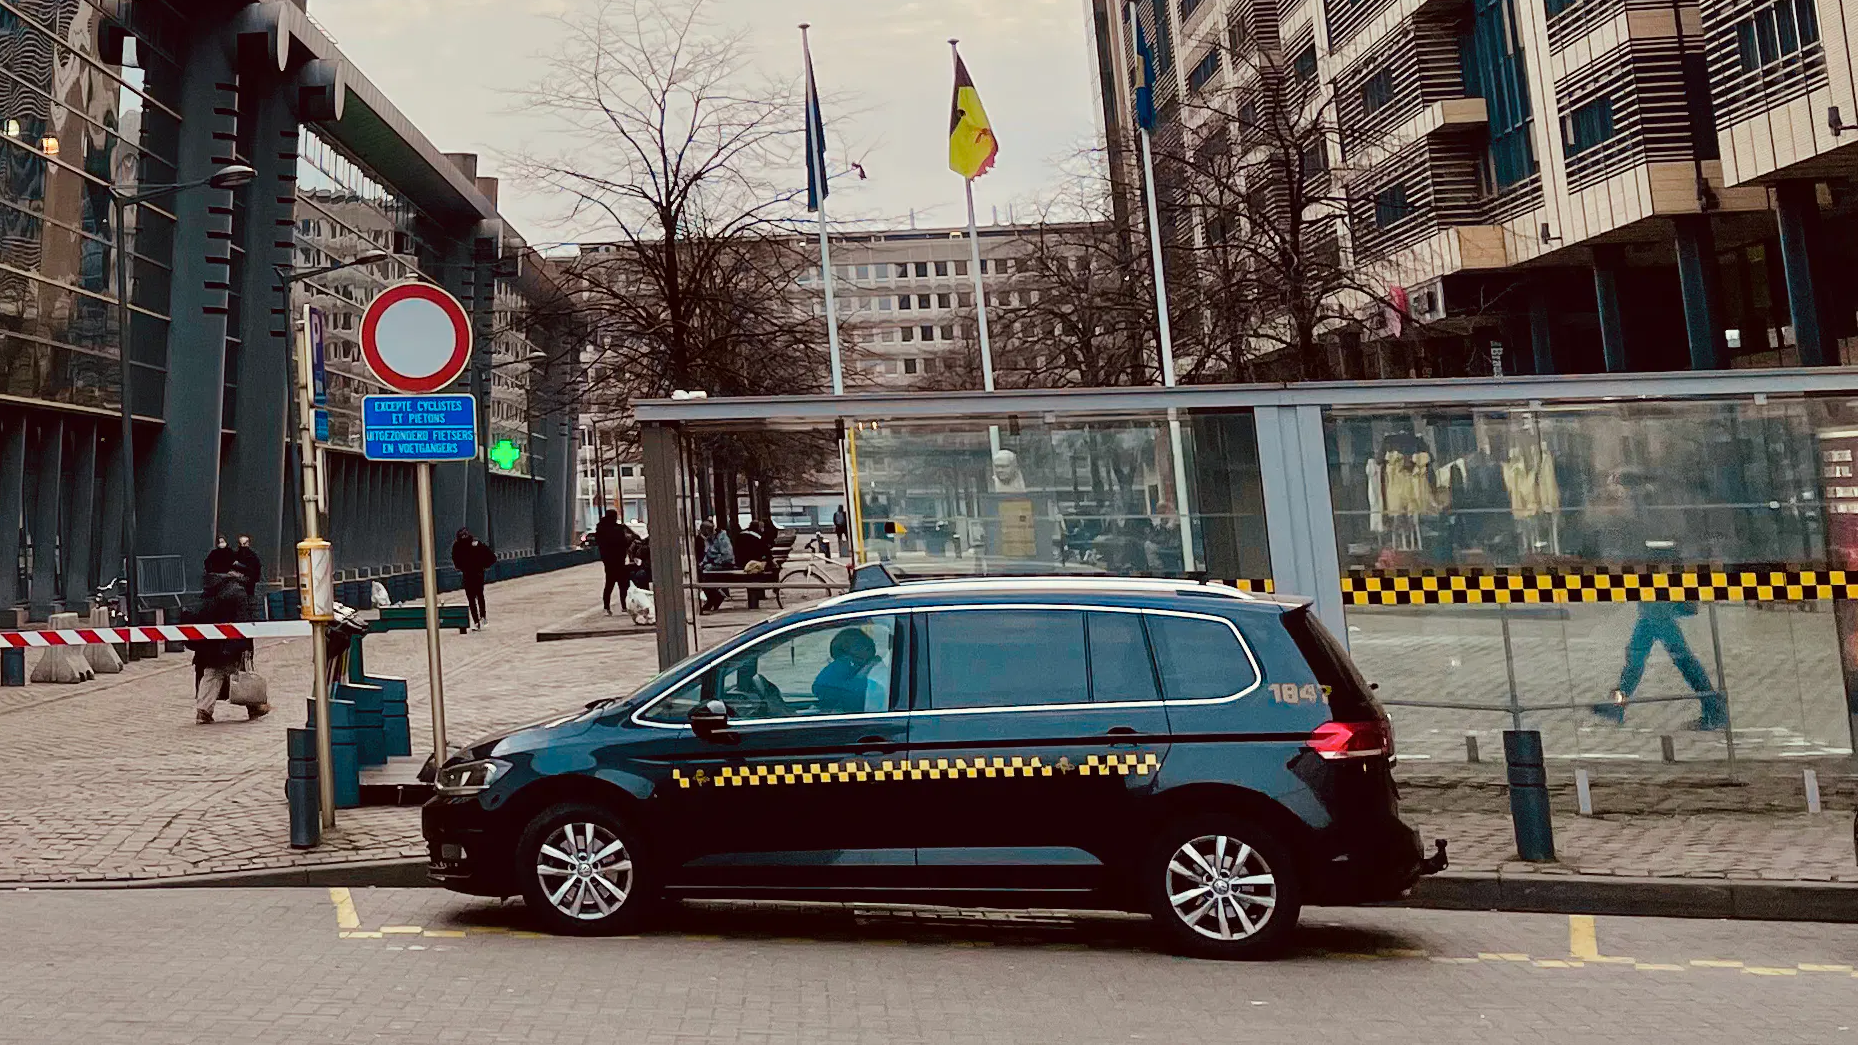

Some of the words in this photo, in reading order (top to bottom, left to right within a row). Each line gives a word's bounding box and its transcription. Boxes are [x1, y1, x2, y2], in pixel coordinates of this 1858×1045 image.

[417, 400, 463, 412] CYCLISTES
[392, 413, 403, 425] ET
[366, 430, 429, 442] UITGEZONDERD
[433, 430, 474, 441] FIETSERS
[382, 442, 394, 454] EN
[398, 442, 459, 454] VOETGANGERS
